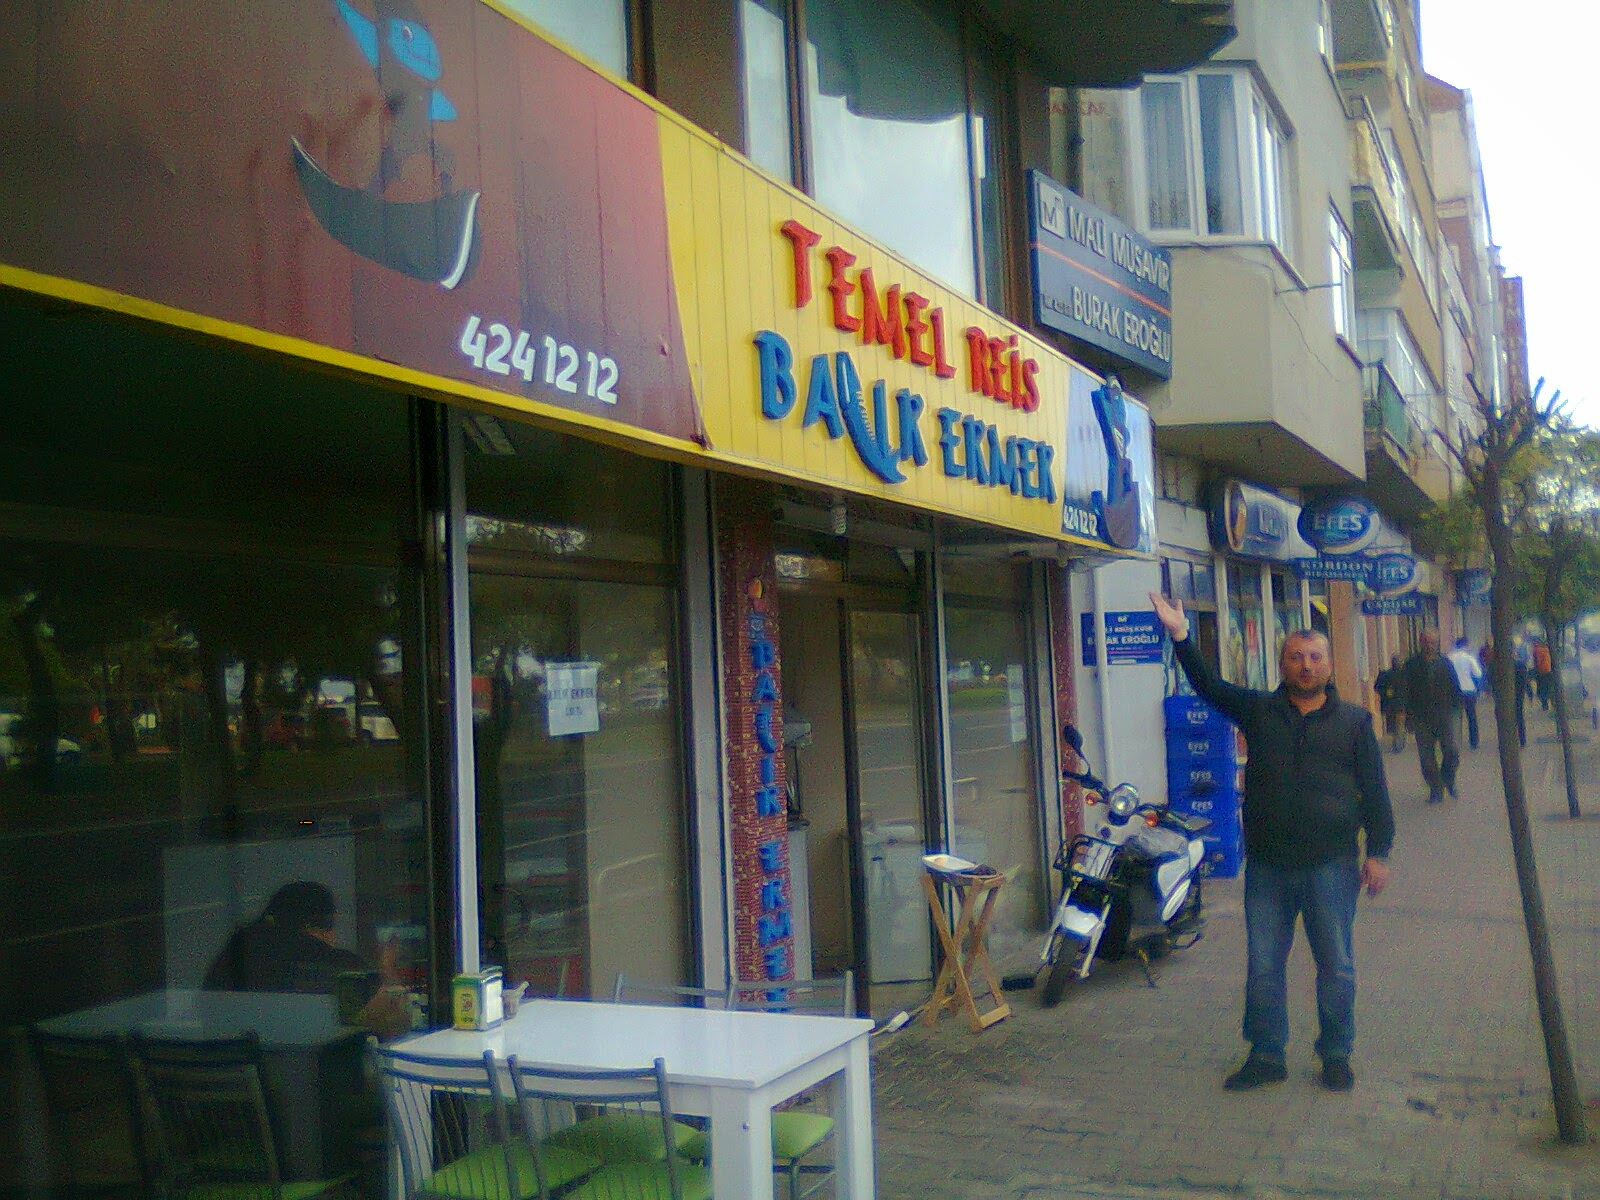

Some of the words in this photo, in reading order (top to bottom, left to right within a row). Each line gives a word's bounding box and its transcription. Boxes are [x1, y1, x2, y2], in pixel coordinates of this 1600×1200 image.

[780, 218, 957, 380] TEMEL
[965, 324, 1041, 414] REİS
[1073, 285, 1121, 339] BURAK
[1124, 315, 1171, 363] EROĞLU
[1112, 231, 1170, 293] MÜŞAVİR
[752, 329, 930, 485] BALIK
[938, 406, 1058, 505] EKMEK
[1313, 513, 1363, 531] EFES
[751, 640, 782, 817] BALIK
